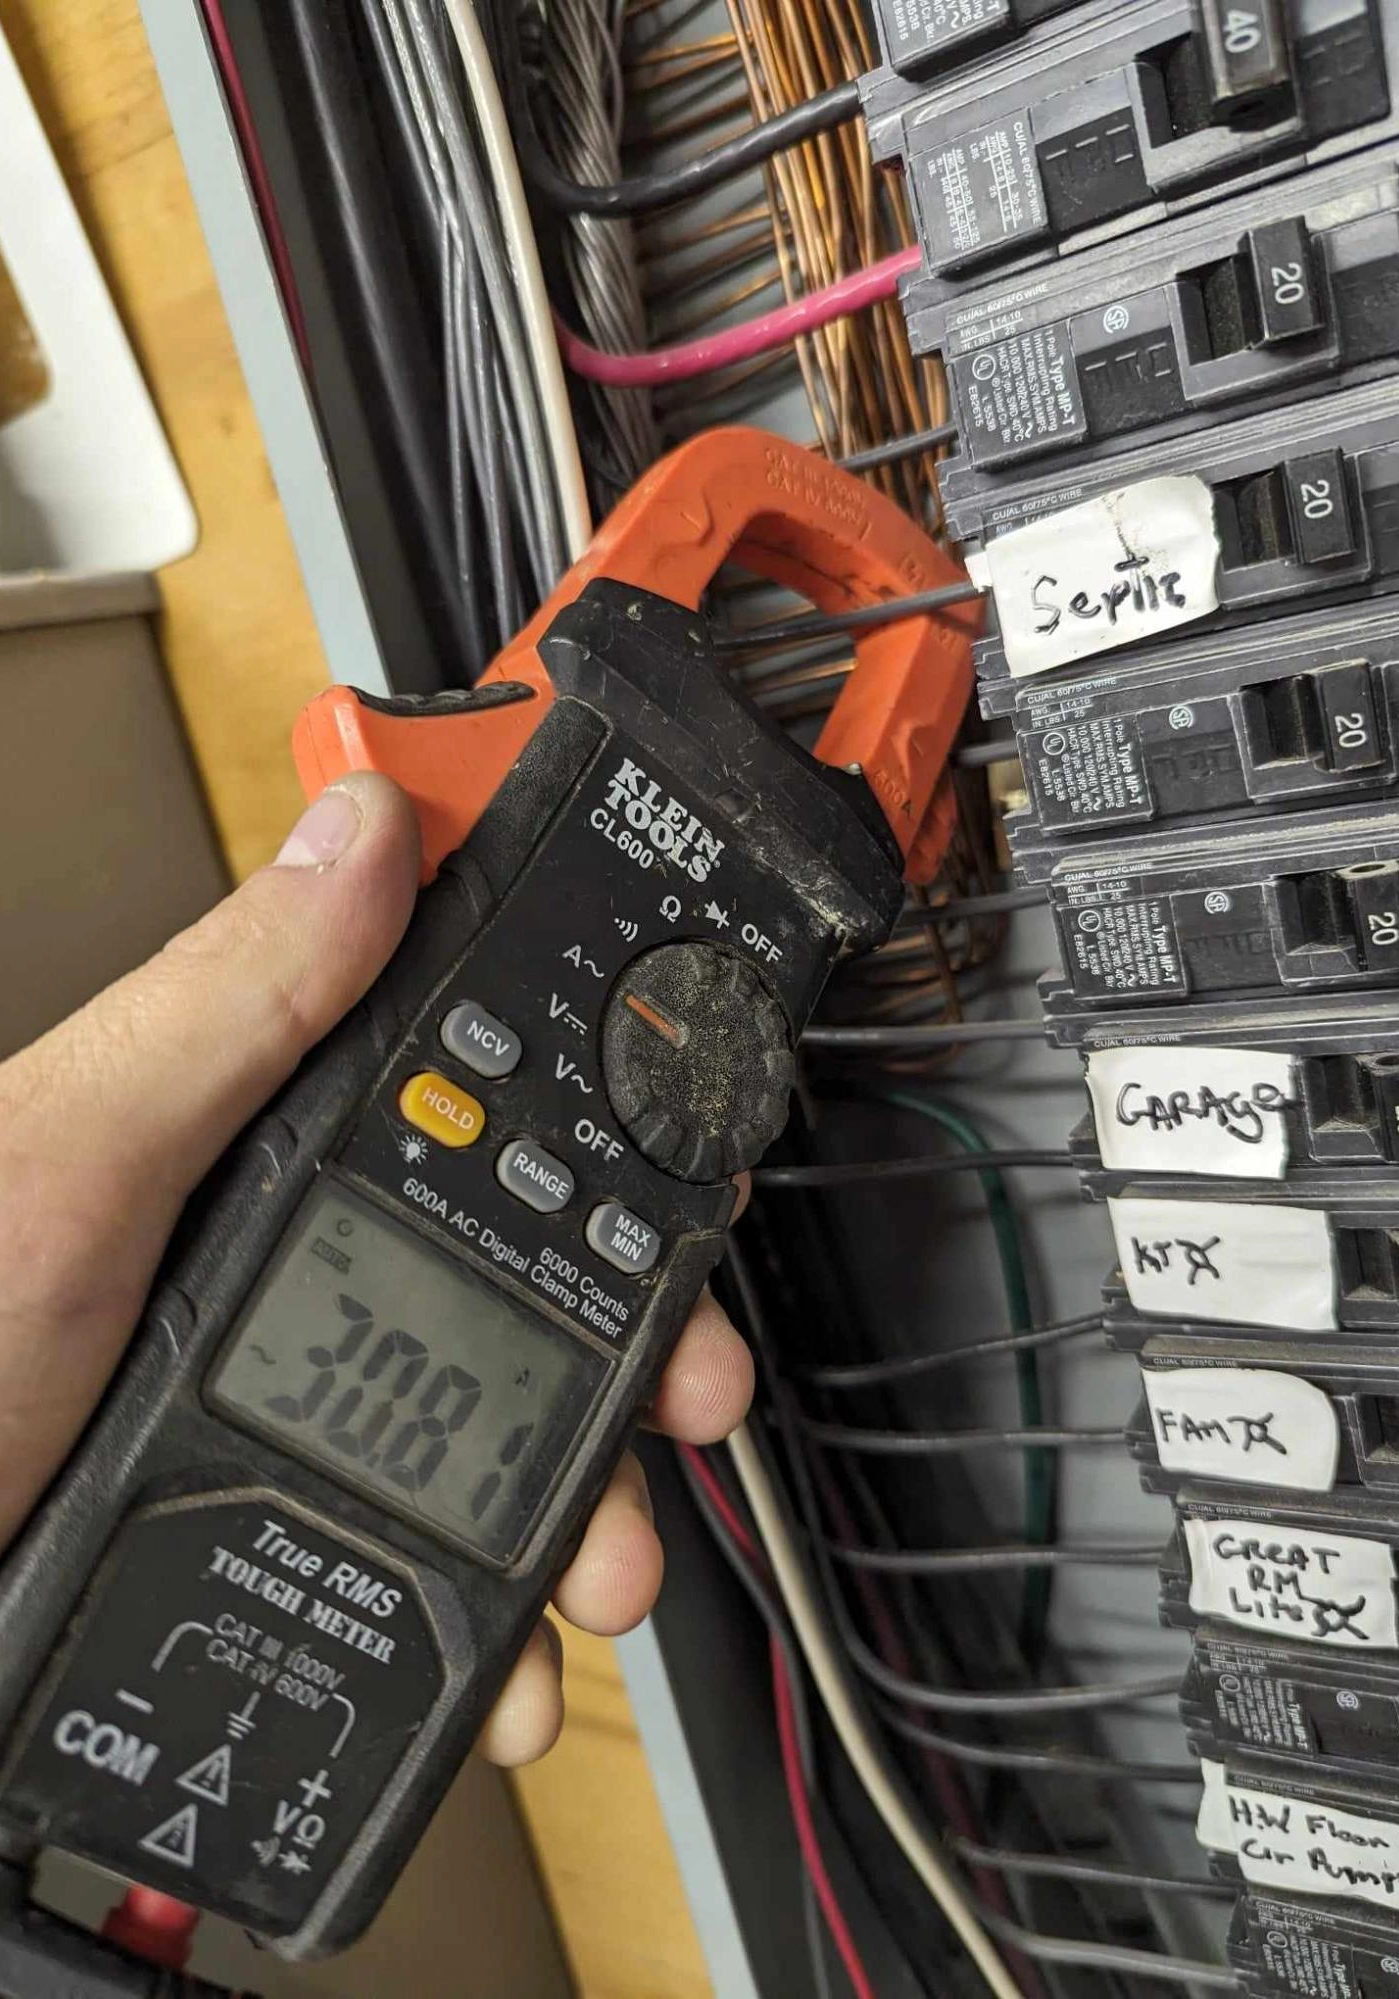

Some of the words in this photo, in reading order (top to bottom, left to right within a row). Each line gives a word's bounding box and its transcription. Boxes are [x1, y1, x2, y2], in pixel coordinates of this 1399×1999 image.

[1224, 8, 1258, 54] 40
[1270, 263, 1305, 306] 20
[1033, 333, 1052, 397] Interrupting
[1046, 397, 1059, 433] Rating
[1050, 356, 1067, 391] Type
[1057, 392, 1076, 426] MP-T
[1058, 488, 1084, 502] WIRE
[1299, 479, 1335, 520] 20
[1334, 713, 1367, 749] 20
[1101, 720, 1118, 776] Interrupting
[1113, 776, 1125, 809] Rating
[1117, 743, 1132, 774] Type
[1125, 775, 1142, 805] MP-T
[604, 779, 712, 884] TOOLS
[615, 757, 726, 864] KLEIN
[588, 807, 655, 870] CL600
[740, 922, 784, 965] OFF
[1073, 934, 1088, 970] E82615
[1152, 925, 1168, 953] Type
[1368, 911, 1399, 947] 20
[1159, 955, 1178, 983] MP-T
[466, 1018, 511, 1058] NCV
[420, 1086, 476, 1131] HOLD
[573, 1117, 626, 1163] OFF
[513, 1151, 570, 1200] RANGE
[610, 1233, 643, 1263] MIN
[614, 1213, 652, 1248] MAX
[402, 1177, 450, 1220] 600A
[449, 1209, 479, 1238] AC
[478, 1229, 529, 1273] Digital
[530, 1265, 579, 1313] Clamp
[579, 1301, 623, 1340] Meter
[539, 1245, 579, 1285] 6000
[579, 1276, 630, 1322] Counts
[250, 1519, 324, 1579] True
[323, 1561, 403, 1618] RMS
[207, 1545, 308, 1616] TOUGH
[303, 1597, 397, 1664] METER
[206, 1638, 256, 1674] CAT
[274, 1673, 330, 1712] 600V
[214, 1613, 264, 1648] CAT
[283, 1650, 347, 1691] 1000V
[53, 1709, 161, 1786] COM
